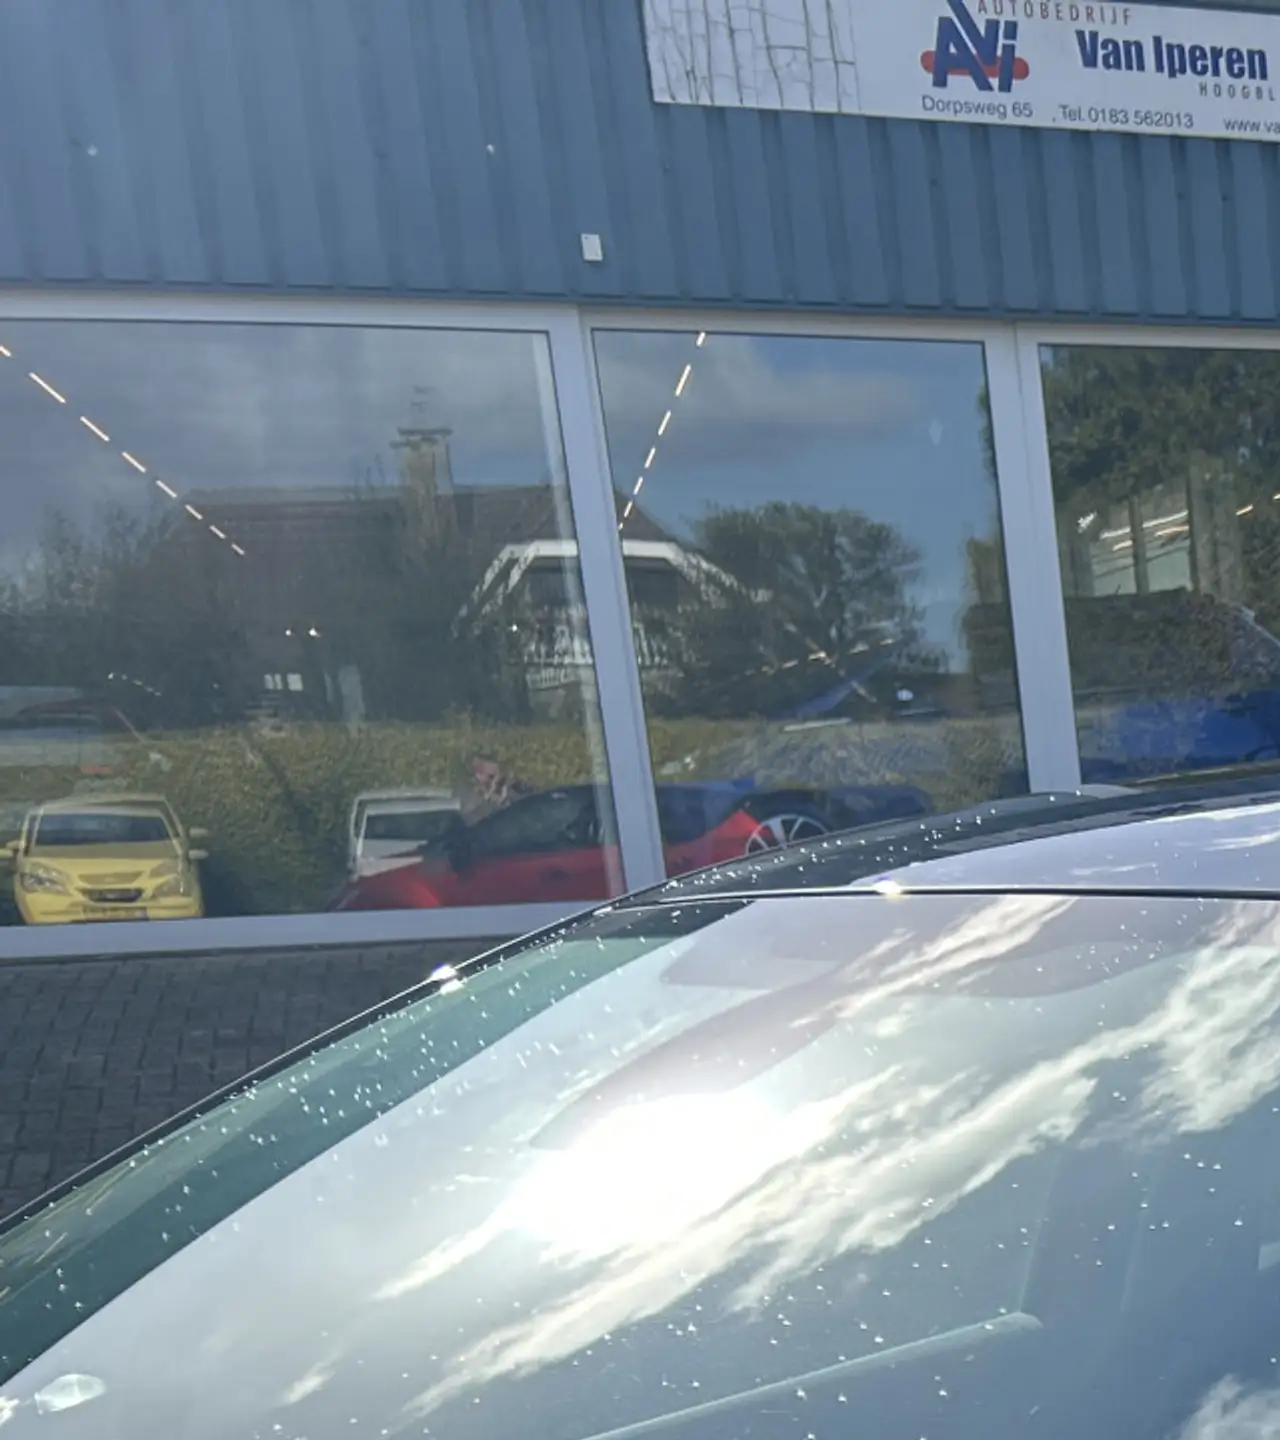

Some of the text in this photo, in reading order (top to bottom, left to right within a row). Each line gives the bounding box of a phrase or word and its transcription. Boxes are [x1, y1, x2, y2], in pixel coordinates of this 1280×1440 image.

[977, 0, 1132, 26] AUTOBEDRIJF
[1075, 29, 1269, 81] Van Iperen
[921, 94, 1008, 120] Dorpsweg
[1012, 101, 1034, 118] 65
[1087, 106, 1129, 125] 0183
[1133, 109, 1194, 129] 562013
